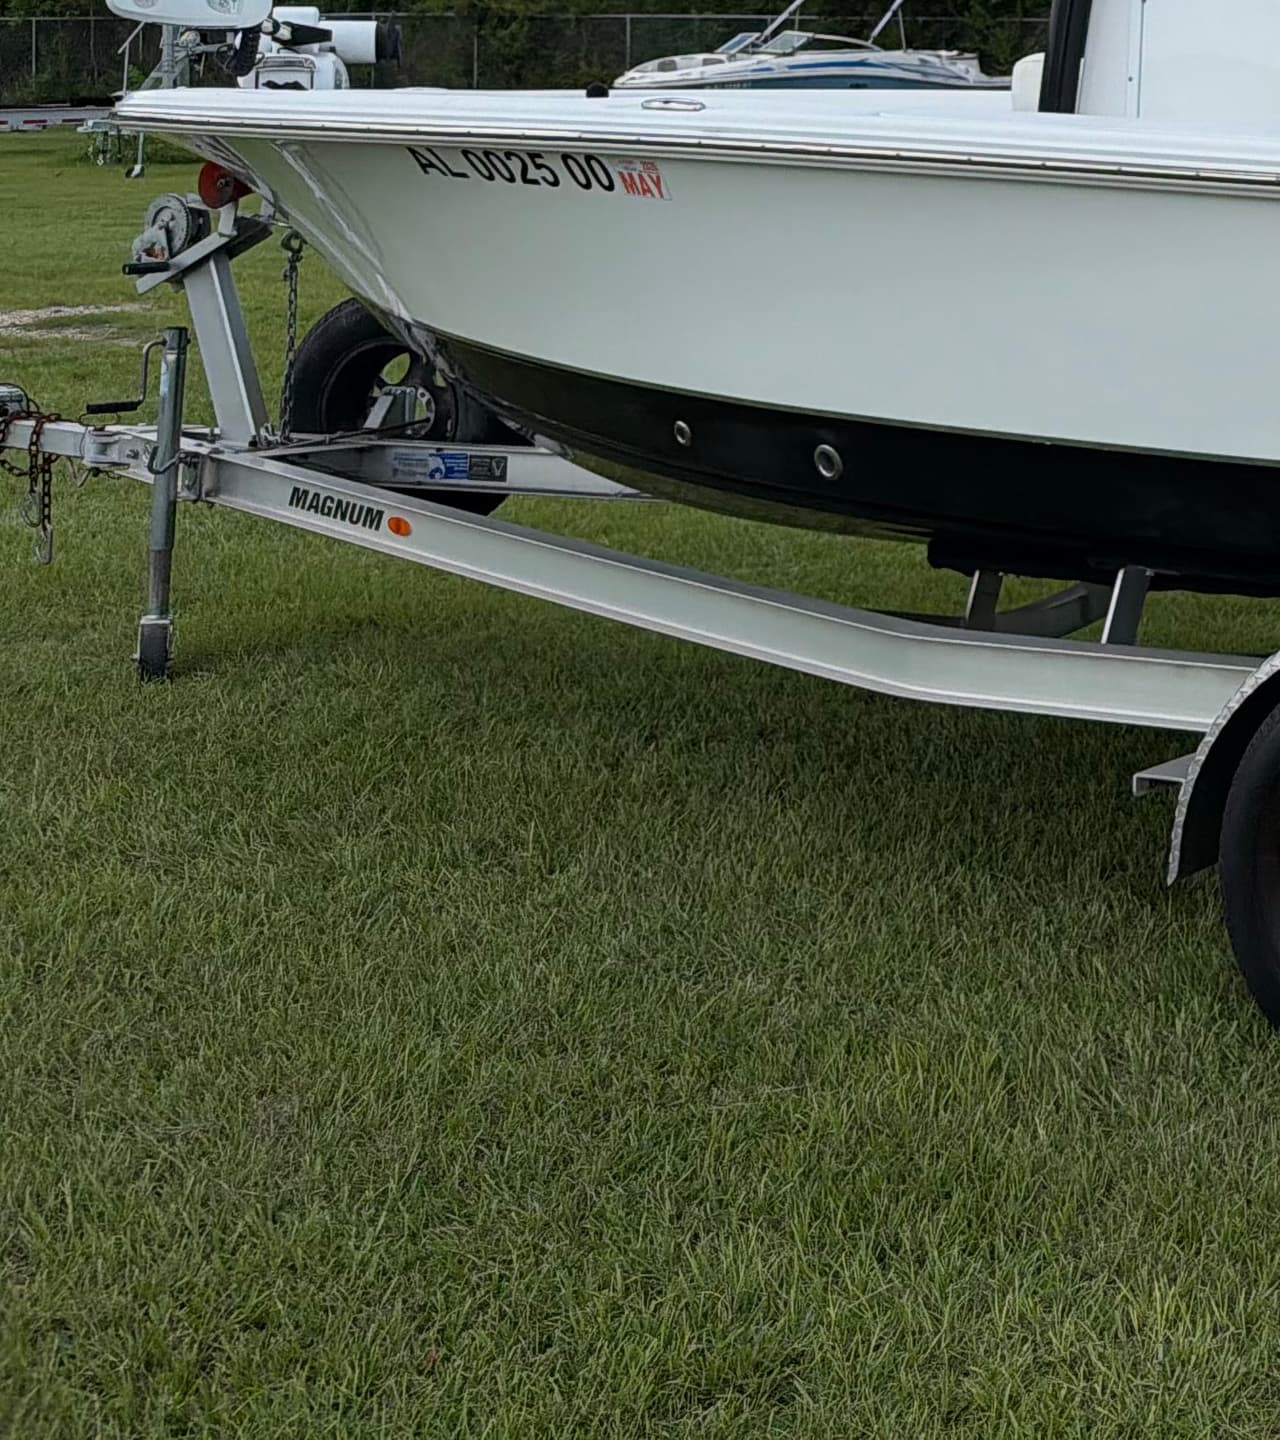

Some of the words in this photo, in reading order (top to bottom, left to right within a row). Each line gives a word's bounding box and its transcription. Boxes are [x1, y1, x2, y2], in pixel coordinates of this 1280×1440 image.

[405, 146, 470, 179] AL
[461, 148, 560, 188] 0025
[560, 153, 615, 192] 00
[617, 170, 665, 200] MAY
[288, 486, 385, 532] MAGNUM
